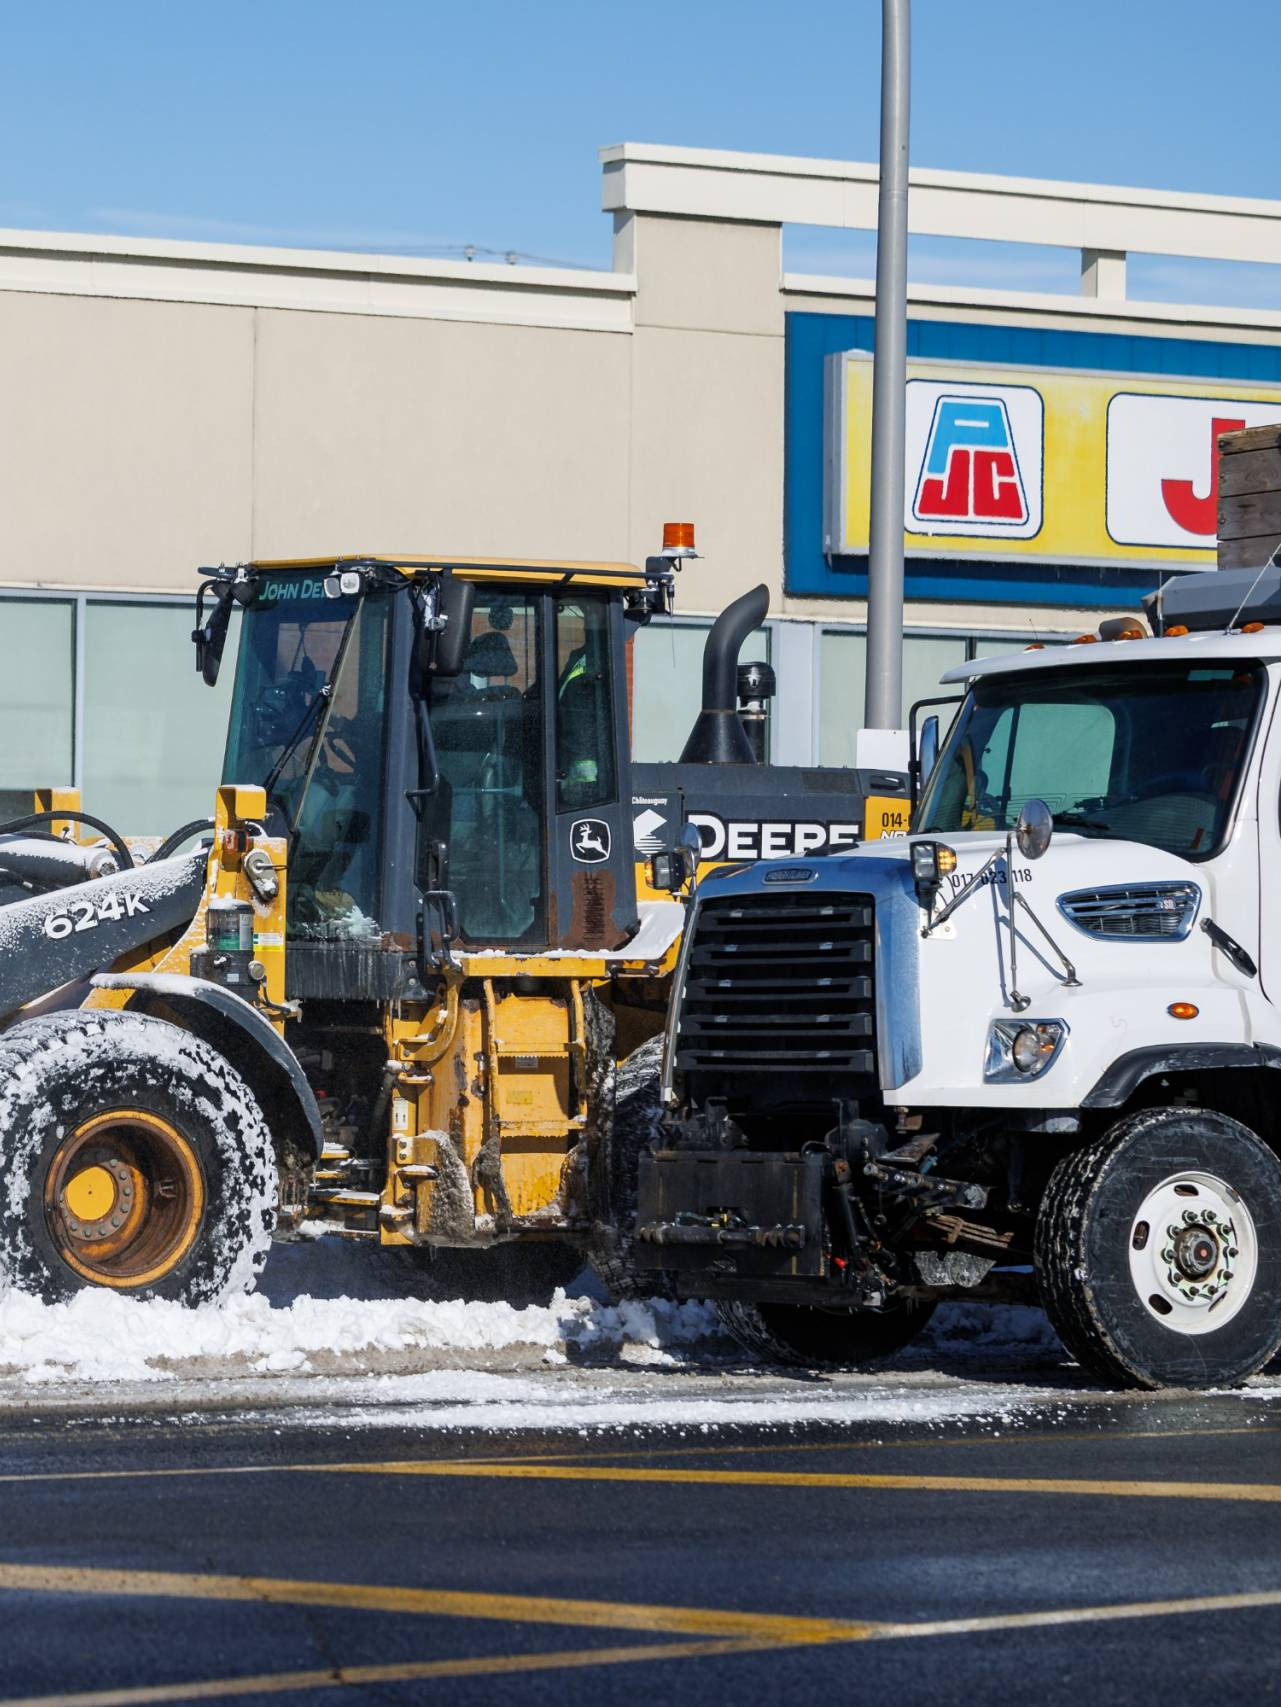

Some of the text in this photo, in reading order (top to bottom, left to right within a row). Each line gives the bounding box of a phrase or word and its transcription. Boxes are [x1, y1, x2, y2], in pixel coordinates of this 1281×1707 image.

[259, 579, 326, 600] JOHN DE
[44, 892, 151, 939] 624K
